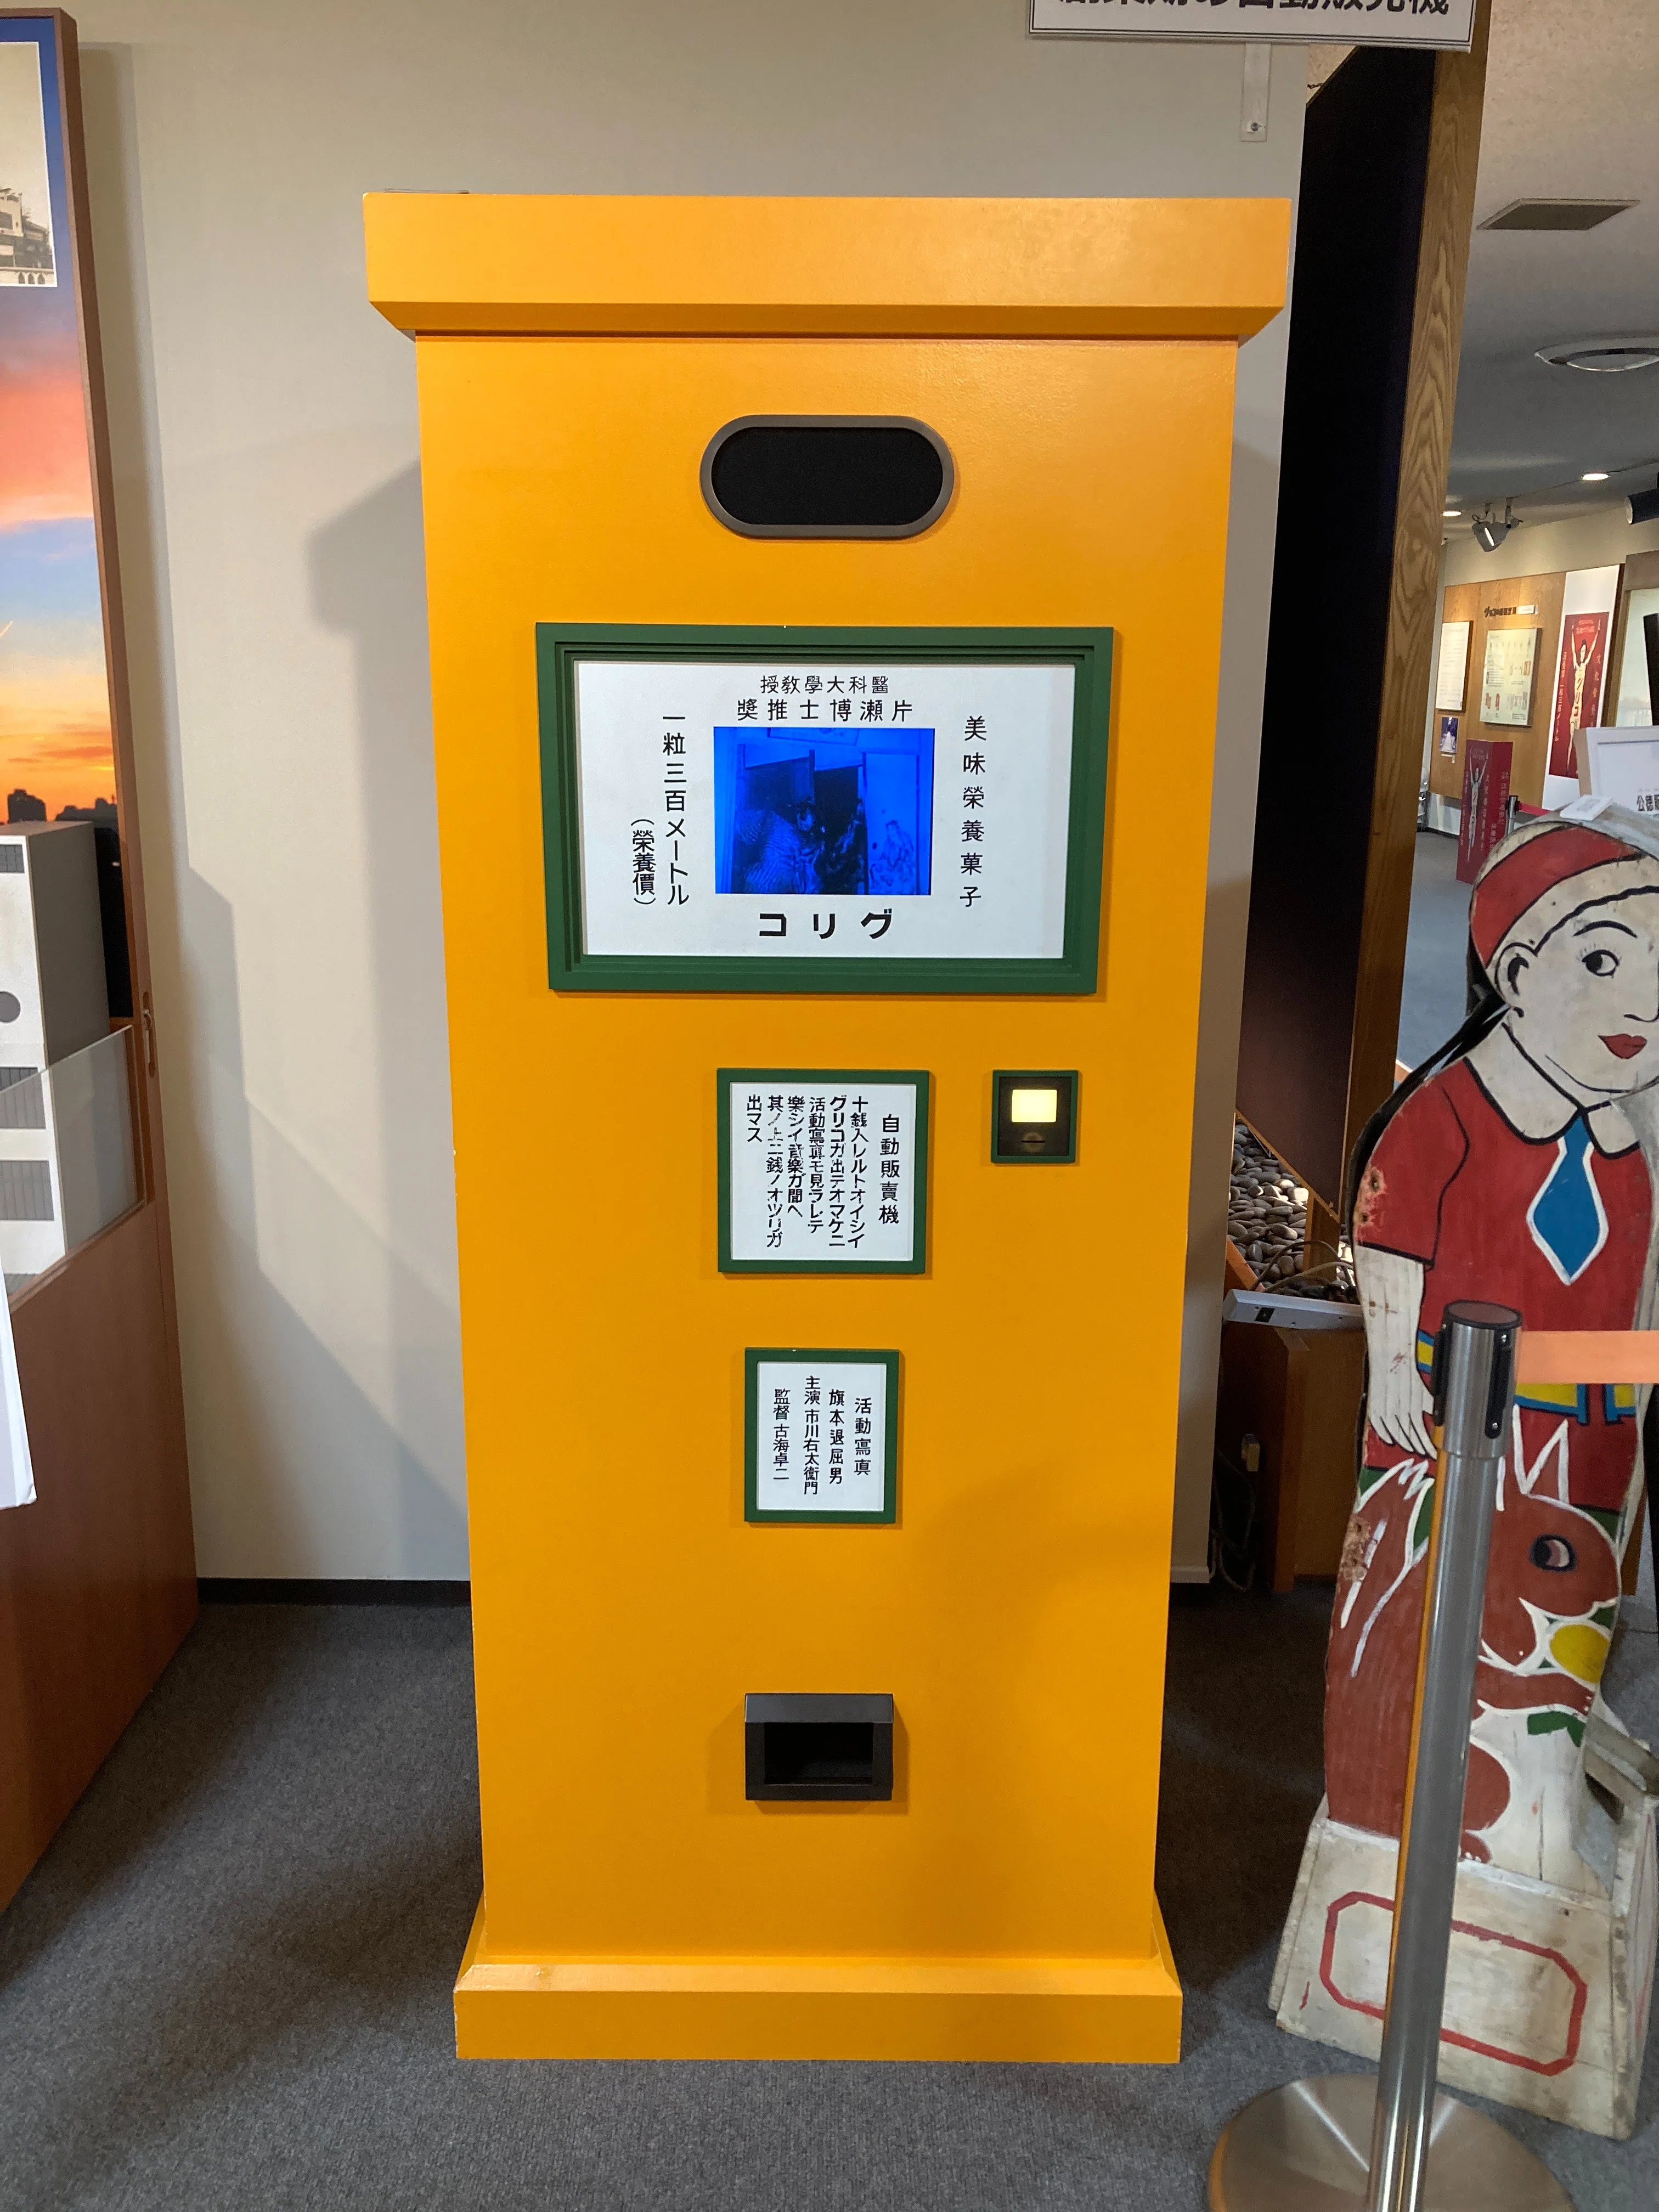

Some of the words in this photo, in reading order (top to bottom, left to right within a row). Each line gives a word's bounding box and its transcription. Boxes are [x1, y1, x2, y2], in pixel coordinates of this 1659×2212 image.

[663, 716, 689, 905] 一粒三百メートル
[960, 716, 986, 907] 美味榮養菓子
[747, 1094, 762, 1142] 出マス
[878, 1114, 900, 1224] 自動販賣機
[773, 1389, 790, 1420] 監督
[804, 1376, 820, 1404] 主演
[773, 1424, 789, 1479] 古海卓二
[829, 1389, 844, 1484] 旗本退屈男
